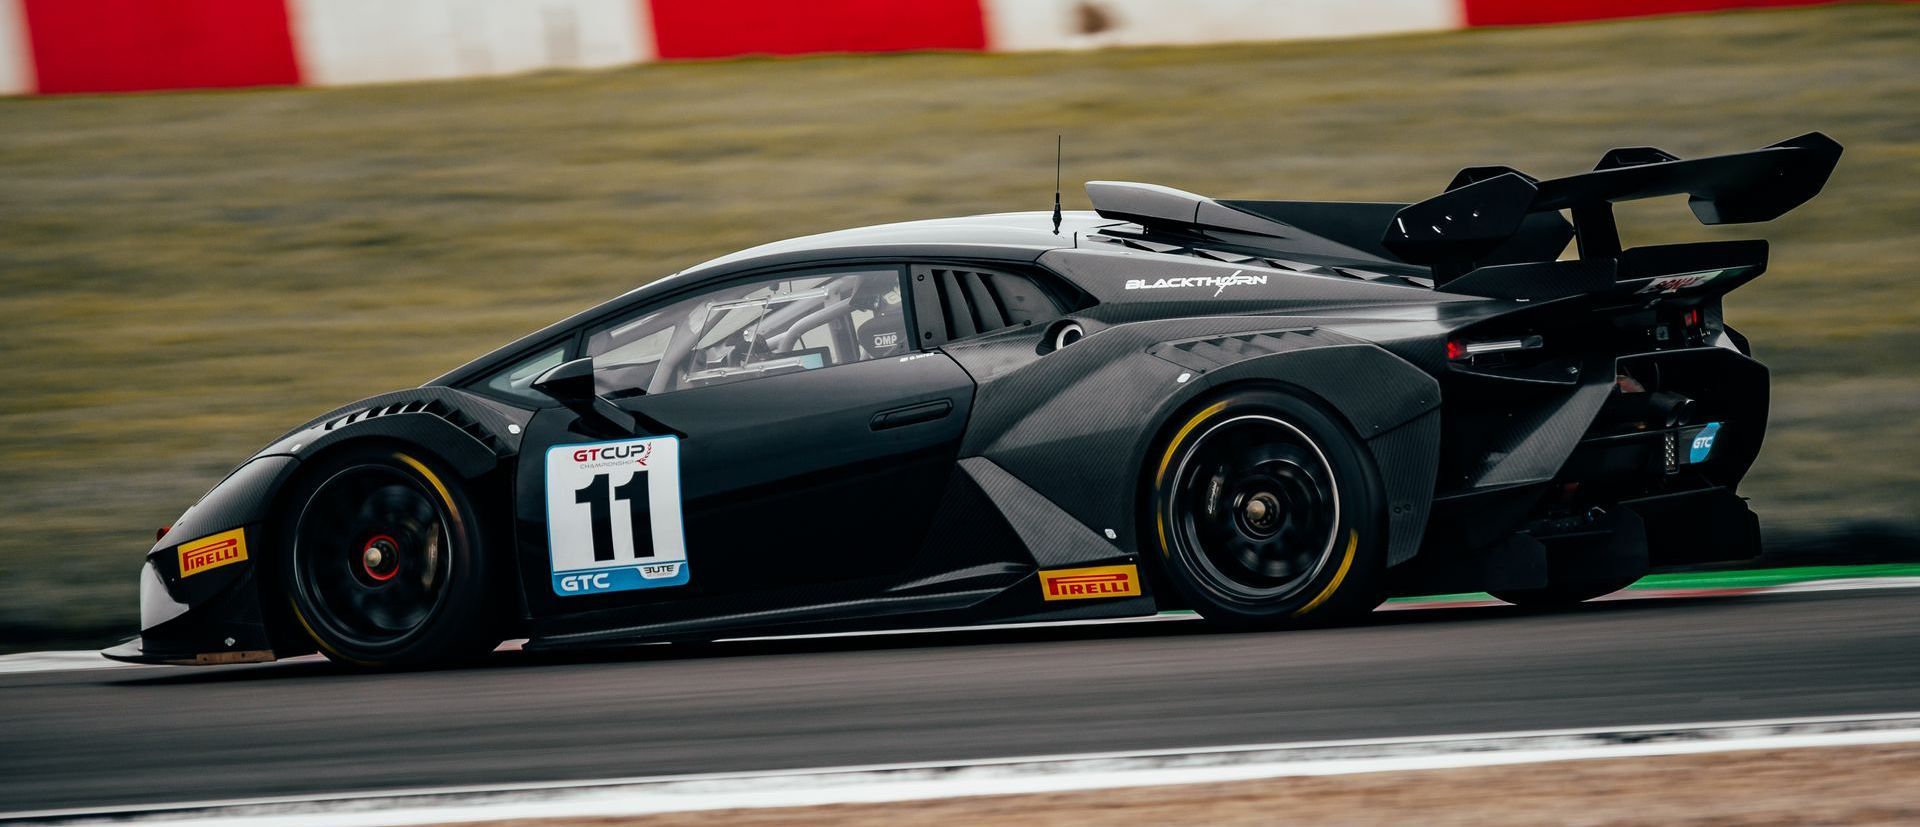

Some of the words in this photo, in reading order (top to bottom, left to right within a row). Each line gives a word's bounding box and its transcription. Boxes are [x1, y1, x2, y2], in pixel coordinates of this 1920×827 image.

[1125, 273, 1267, 293] BLACKTHORN
[874, 334, 898, 346] OMP
[1693, 436, 1713, 449] GTC
[575, 470, 655, 562] 11
[183, 538, 239, 573] PIRELLI
[561, 573, 610, 592] GTC
[1047, 573, 1130, 596] PIRELLI
